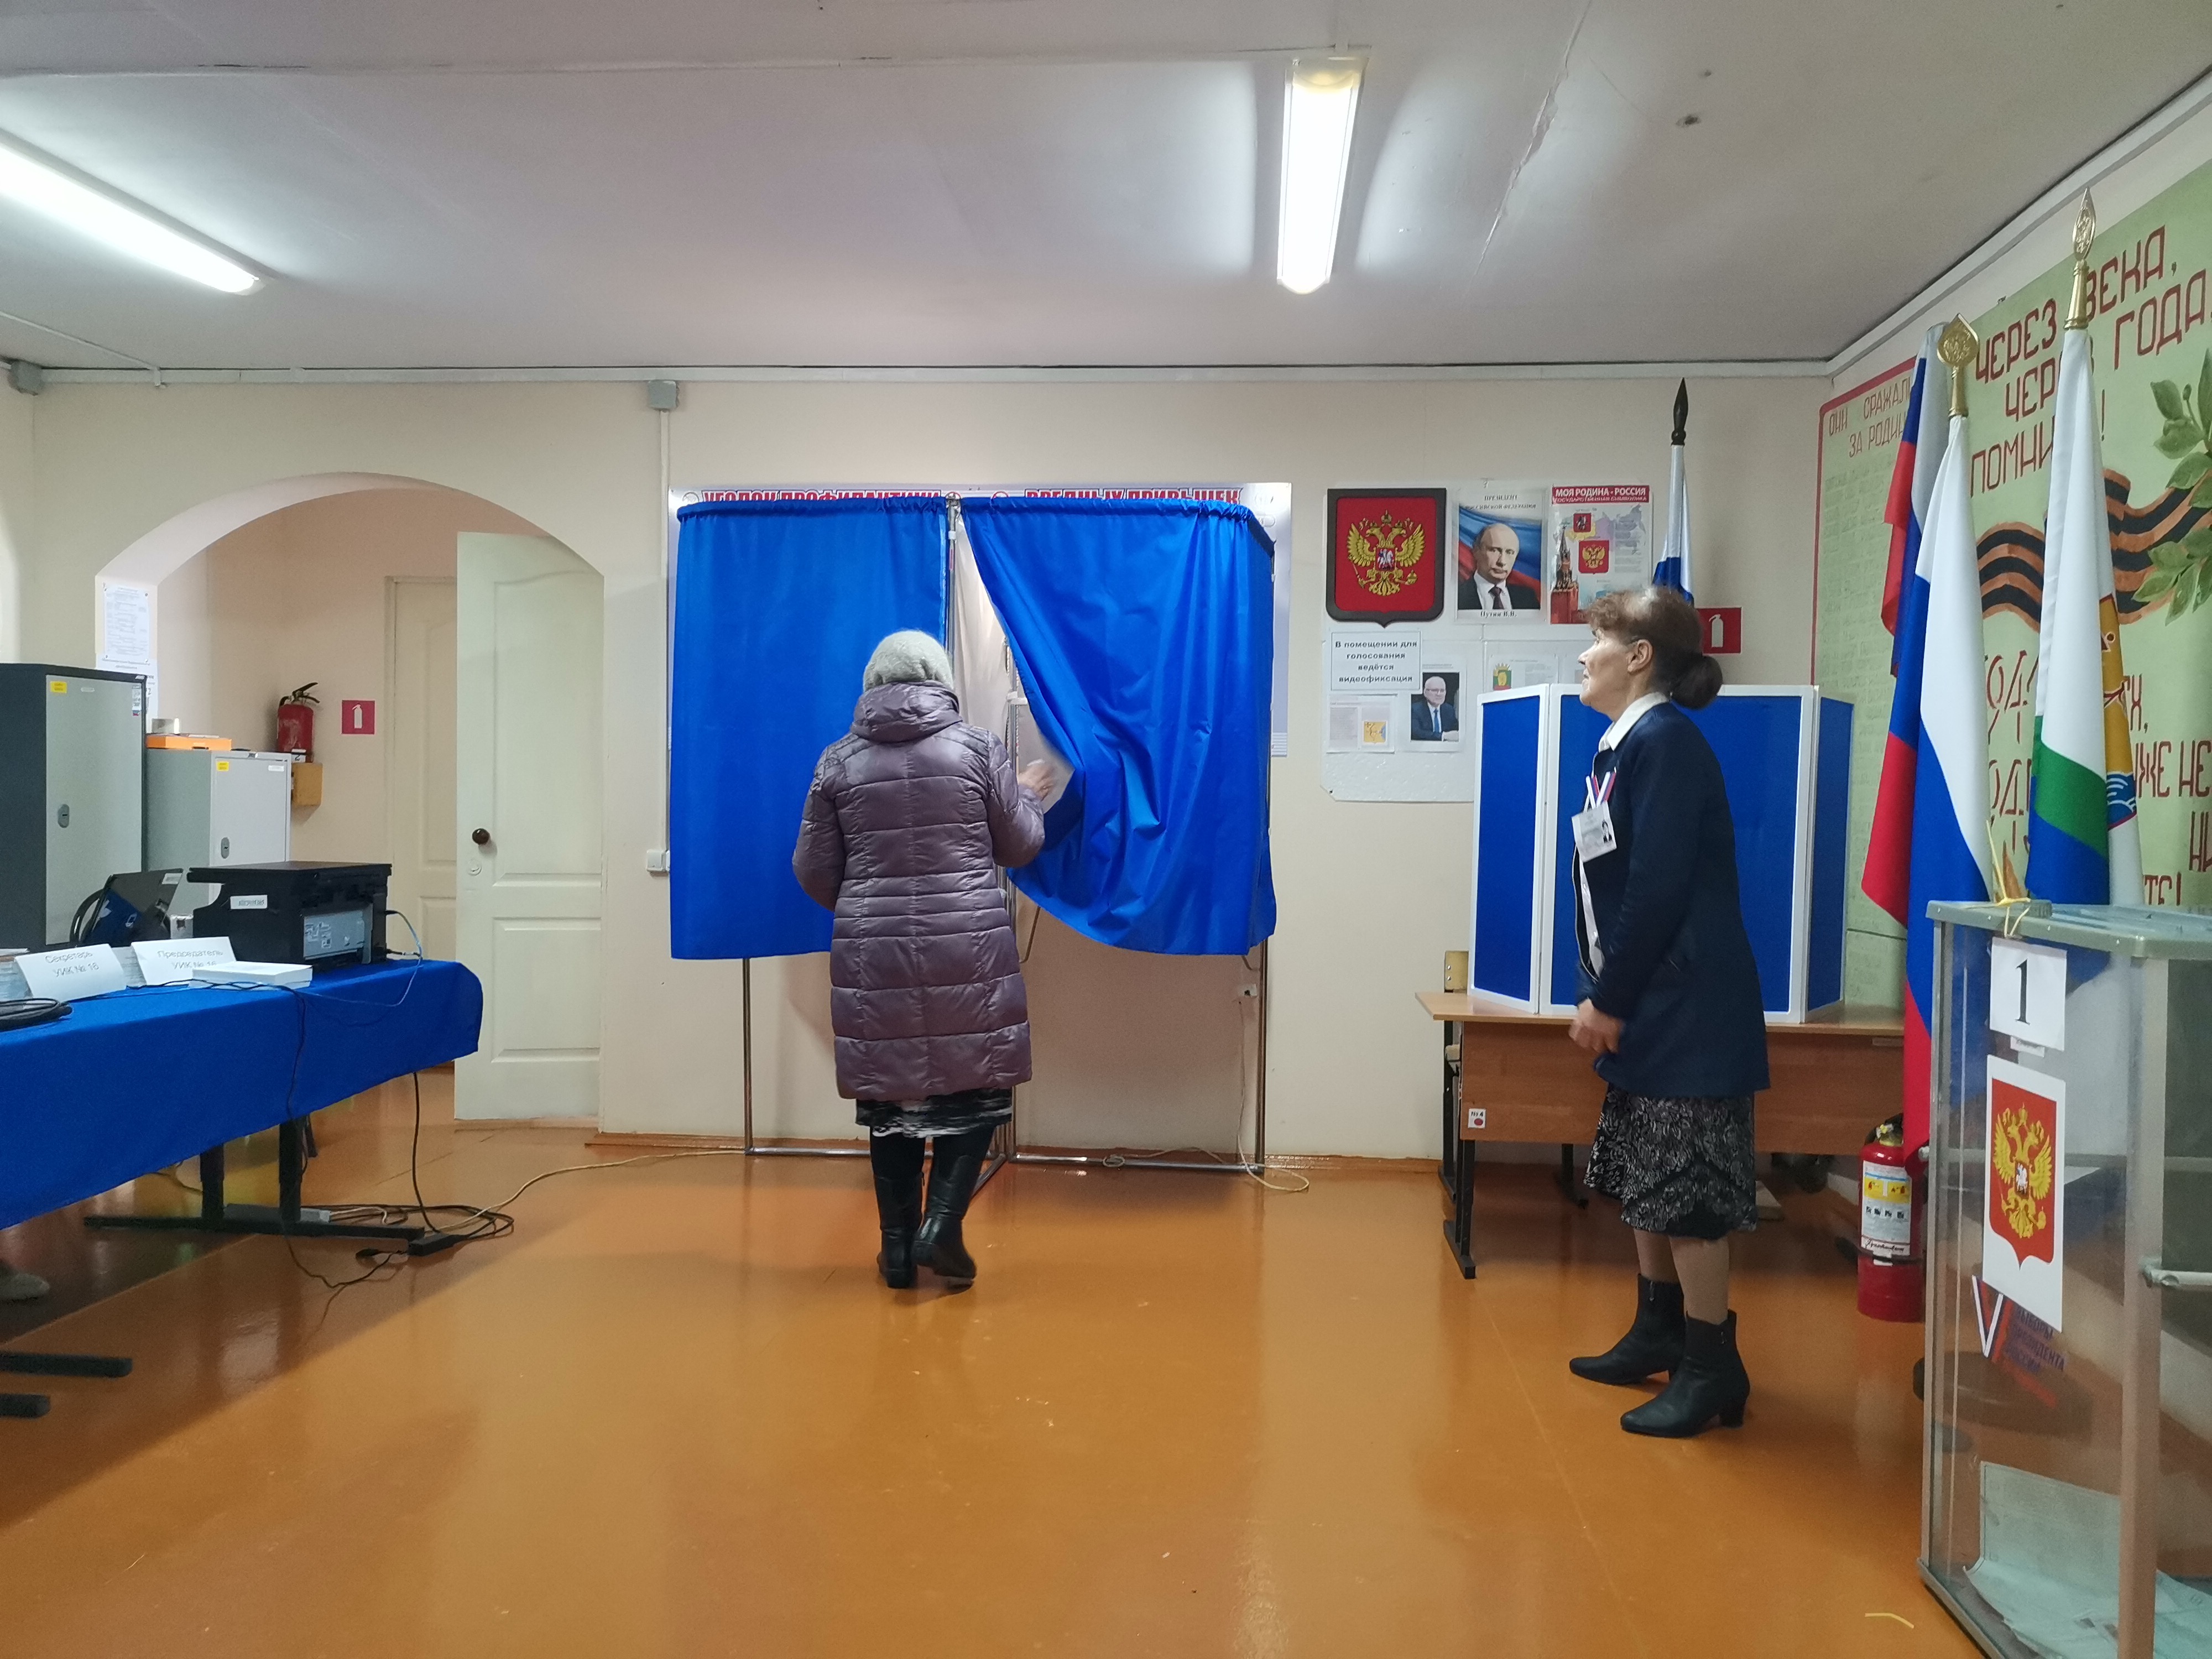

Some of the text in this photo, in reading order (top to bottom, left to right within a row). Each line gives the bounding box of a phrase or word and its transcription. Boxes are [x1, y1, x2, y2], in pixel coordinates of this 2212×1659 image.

[1975, 298, 2057, 384] ЧЕРЕЗ
[1849, 431, 1863, 458] ЗА
[1555, 488, 1574, 497] МОЯ
[1575, 487, 1609, 498] РОДИНА
[1614, 487, 1646, 497] РОССИЯ
[1358, 663, 1394, 671] ведётся
[1339, 675, 1413, 684] видеофиксация
[157, 950, 224, 959] Председатель
[2015, 958, 2031, 1026] 1
